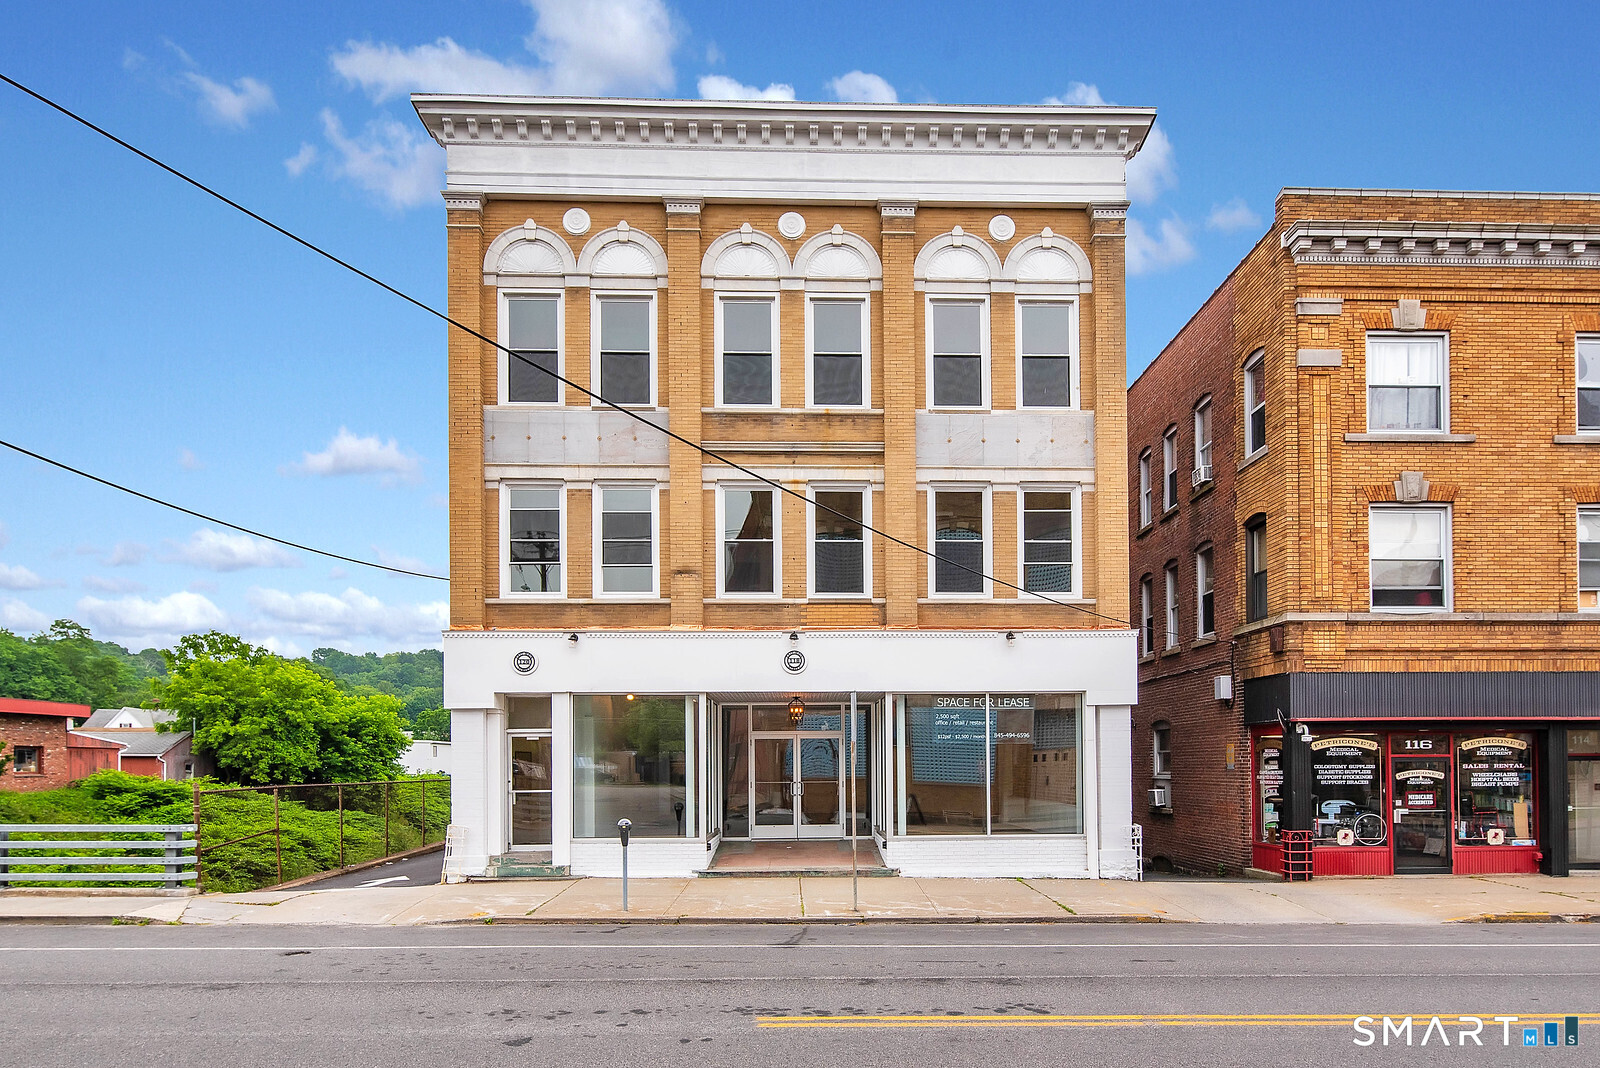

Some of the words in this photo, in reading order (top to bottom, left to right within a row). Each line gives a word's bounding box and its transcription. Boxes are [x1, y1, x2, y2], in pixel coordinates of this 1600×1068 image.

[937, 697, 968, 707] SPACE
[973, 697, 995, 707] FOR
[998, 697, 1030, 707] LEASE
[1313, 739, 1375, 748] PETRICONE'S
[1464, 738, 1525, 748] PETRICONE'S
[1572, 735, 1590, 744] 114
[1405, 740, 1433, 749] 116
